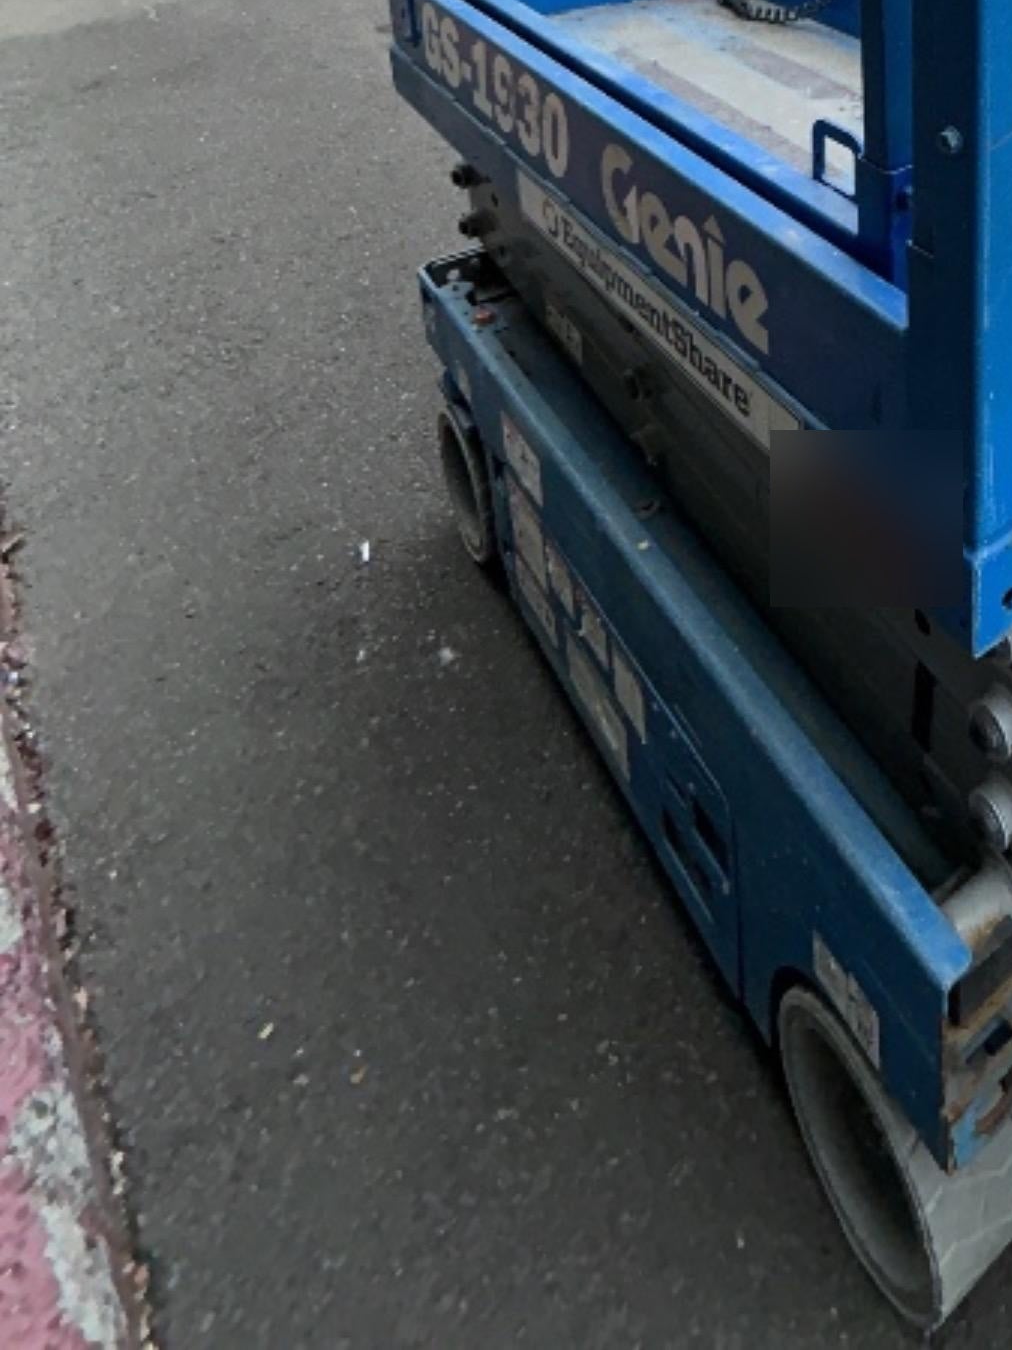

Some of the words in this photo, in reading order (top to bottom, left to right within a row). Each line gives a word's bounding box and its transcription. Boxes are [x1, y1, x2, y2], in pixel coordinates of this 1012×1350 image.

[422, 2, 569, 178] GS-1930
[601, 144, 769, 355] Genie
[560, 214, 751, 418] EquipmentShare
